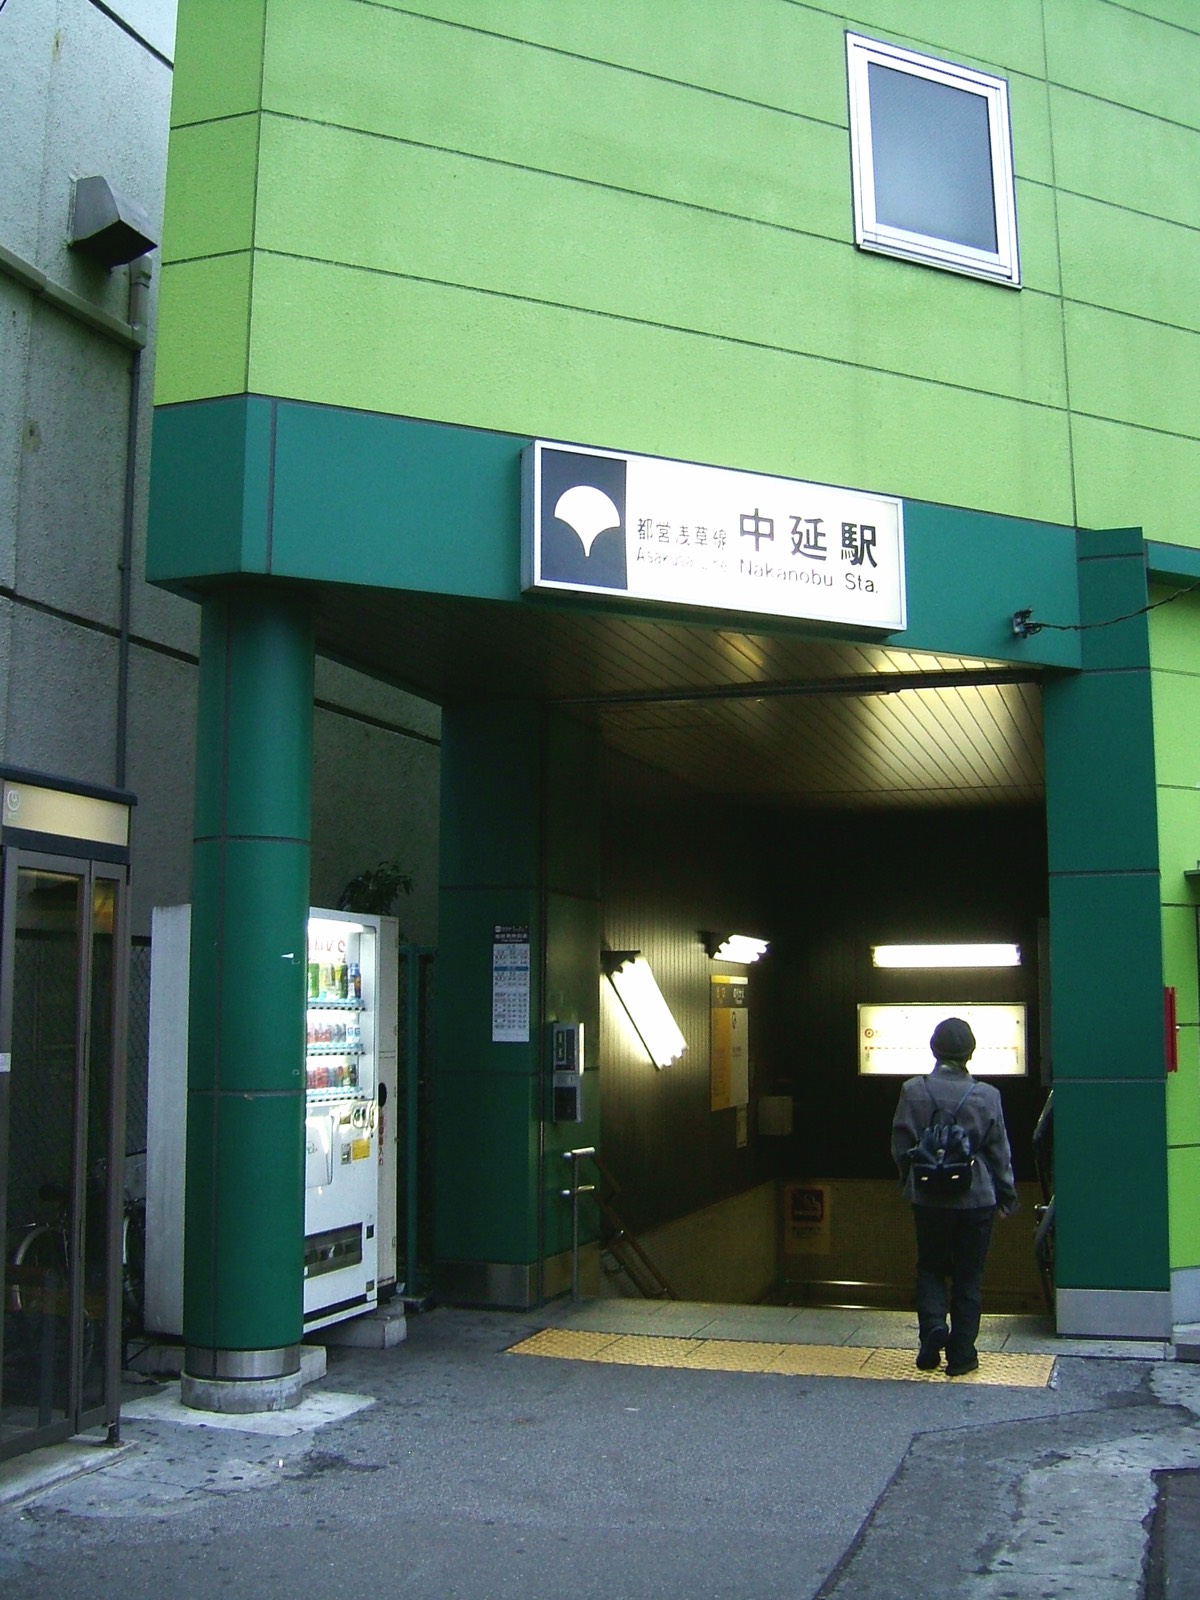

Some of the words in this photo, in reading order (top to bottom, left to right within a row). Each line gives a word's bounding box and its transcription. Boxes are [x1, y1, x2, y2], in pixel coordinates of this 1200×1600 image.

[637, 518, 728, 550] 都営浅草線
[739, 507, 878, 568] 中延駅
[739, 559, 834, 588] Nakanobu
[844, 572, 880, 594] Sta.
